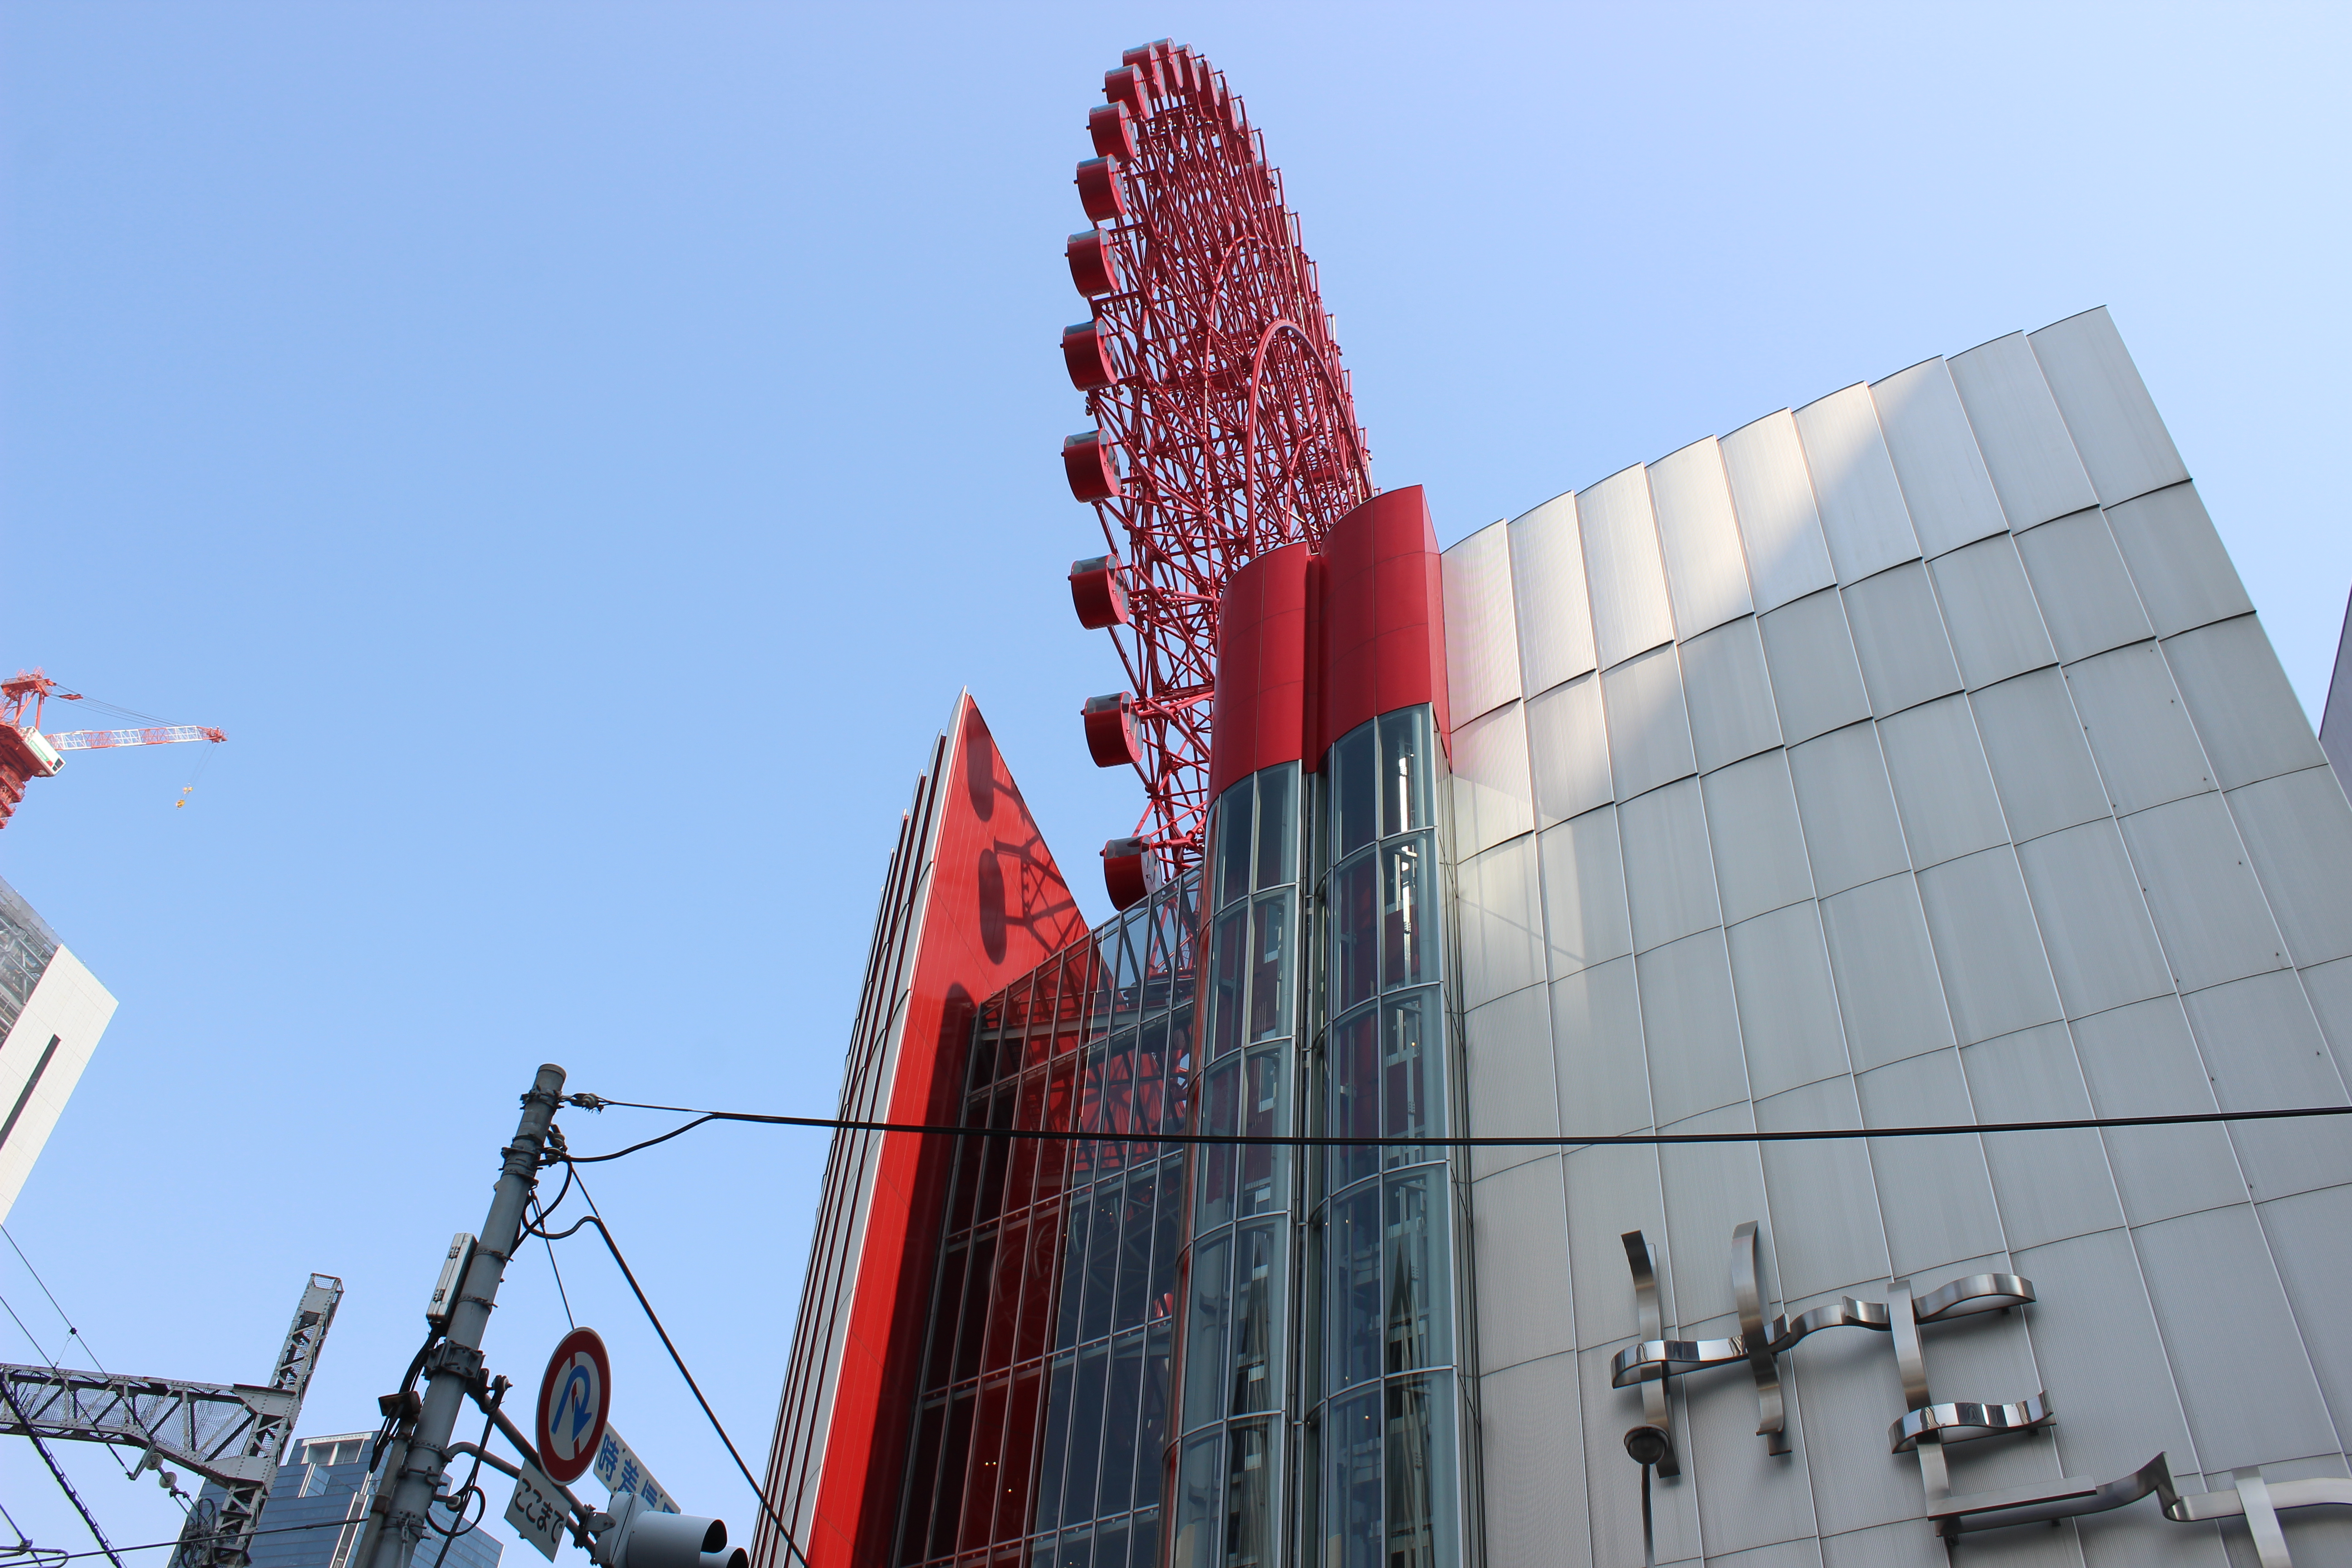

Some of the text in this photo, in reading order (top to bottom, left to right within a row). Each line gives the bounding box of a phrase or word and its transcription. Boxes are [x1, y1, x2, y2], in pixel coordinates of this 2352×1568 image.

[598, 1433, 675, 1514] 時差信
[514, 1478, 564, 1544] ここまで
